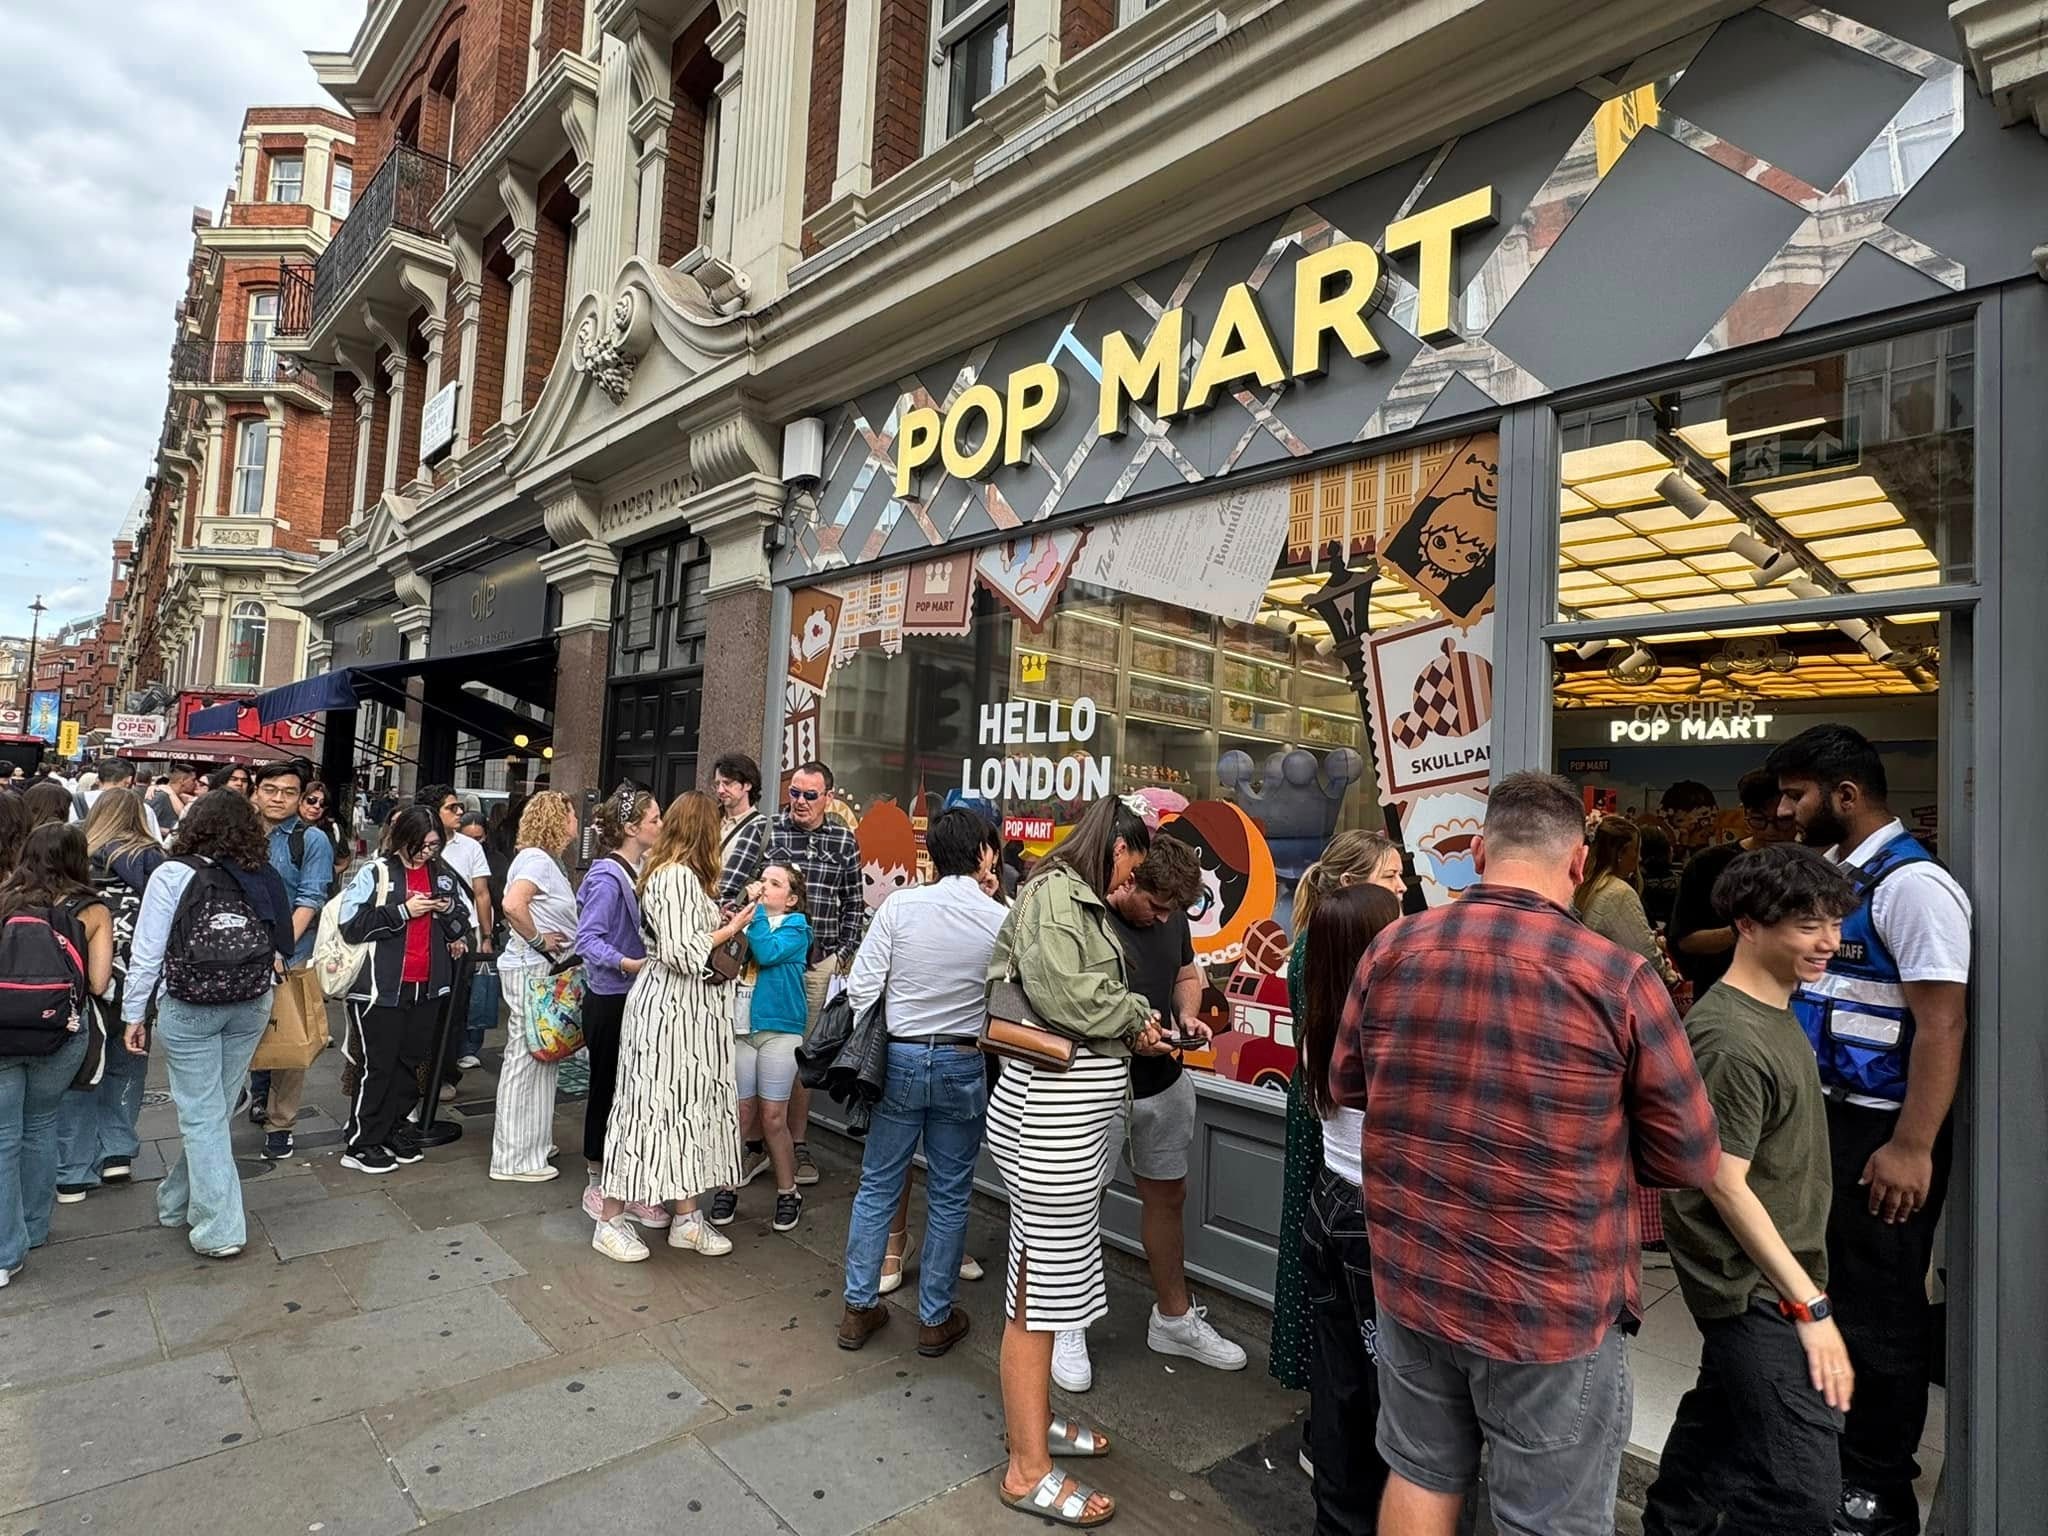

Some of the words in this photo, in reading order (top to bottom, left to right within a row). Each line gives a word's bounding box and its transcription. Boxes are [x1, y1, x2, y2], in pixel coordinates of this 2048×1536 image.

[893, 362, 1066, 500] POP
[1098, 185, 1498, 438] MART
[915, 602, 931, 612] POP
[932, 601, 954, 611] MART
[979, 697, 1096, 745] HELLO
[1634, 700, 1755, 723] CASHIER
[117, 722, 156, 733] OPEN
[1611, 719, 1670, 742] POP
[1681, 715, 1773, 740] MART
[168, 752, 189, 760] FOOD
[961, 755, 1111, 802] LONDON
[1004, 819, 1023, 837] POP
[1024, 821, 1053, 839] MART
